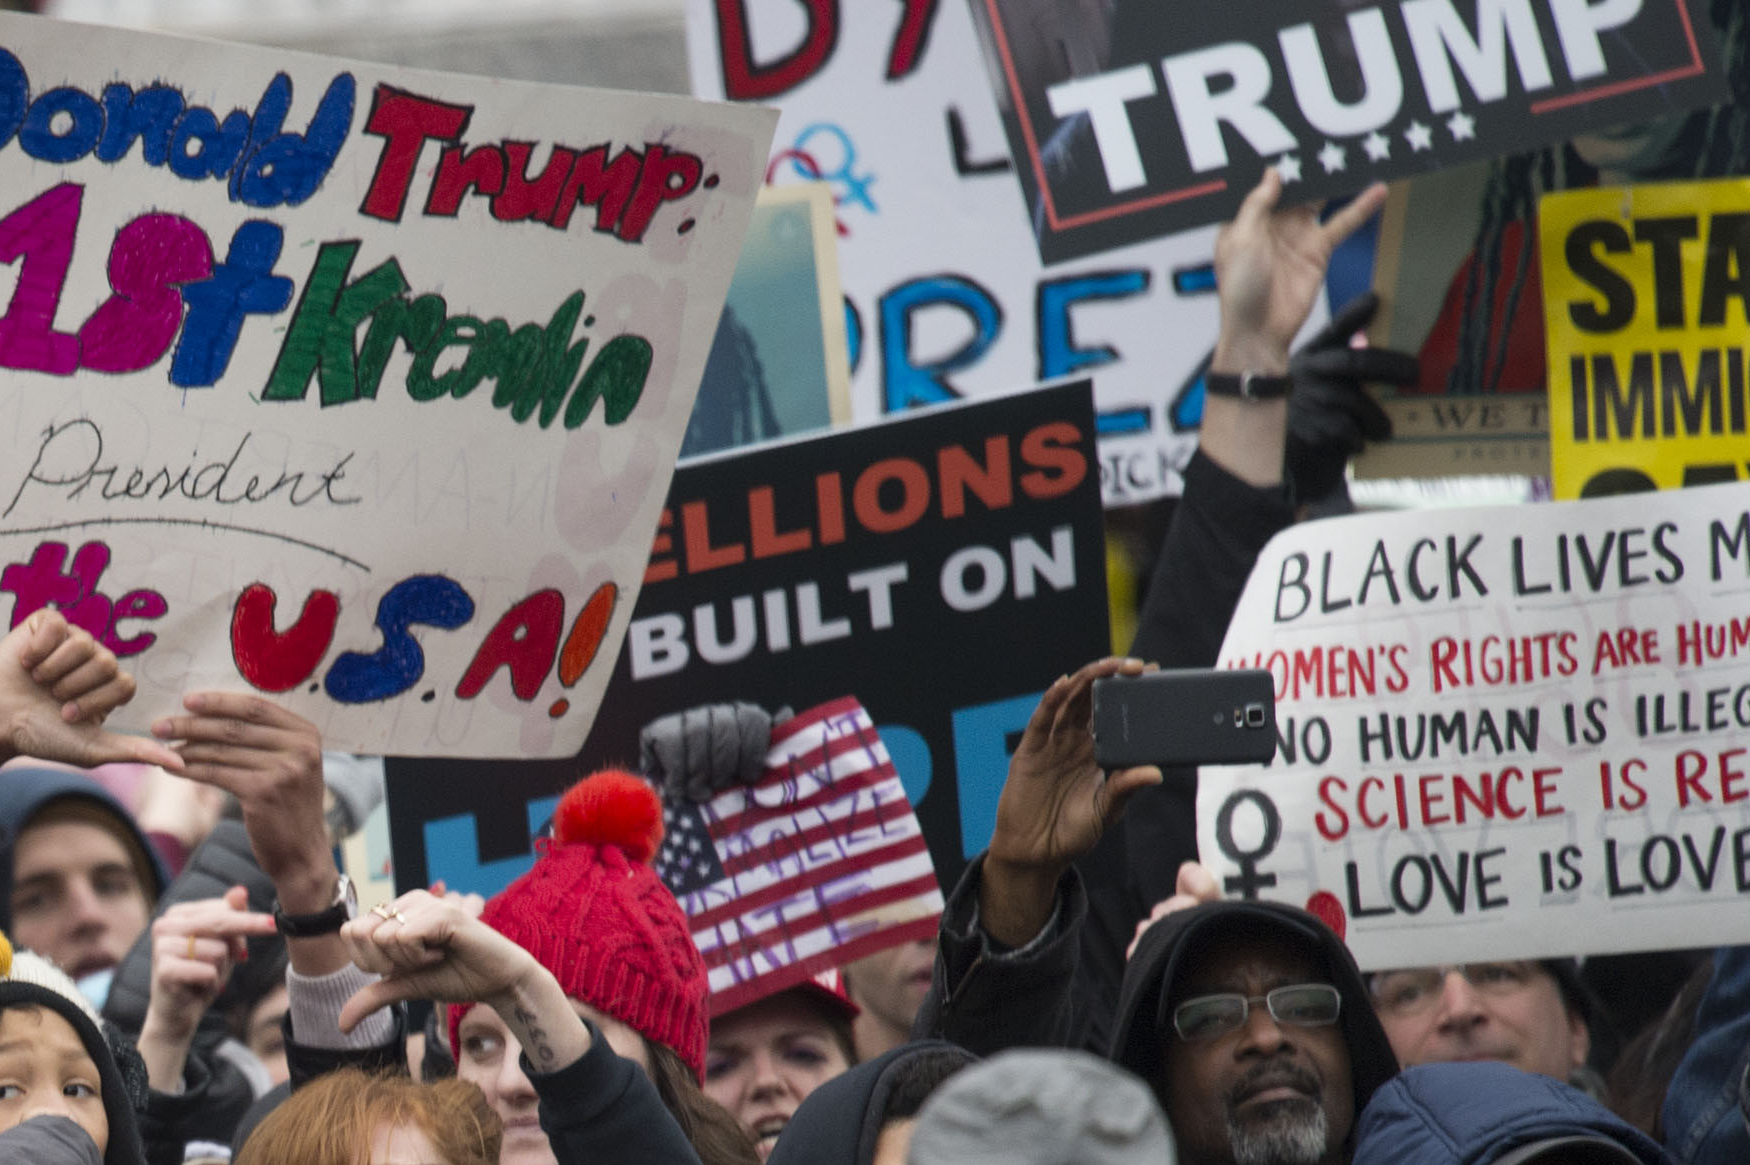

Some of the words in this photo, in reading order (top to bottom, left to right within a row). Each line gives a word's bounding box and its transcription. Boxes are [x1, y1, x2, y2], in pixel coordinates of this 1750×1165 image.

[1047, 0, 1646, 194] TRUMP
[260, 239, 654, 430] Kremlin
[844, 268, 1218, 432] RE
[1, 418, 362, 519] President
[628, 562, 909, 682] BUILT
[940, 525, 1077, 612] ON
[1273, 533, 1489, 624] BLACK
[1513, 520, 1685, 597] LIVES
[1228, 645, 1410, 703] OMEN'S
[1430, 630, 1578, 694] RIGHTS
[1592, 625, 1662, 676] ARE
[1358, 707, 1540, 764] HUMAN
[1563, 697, 1608, 745] IS
[1315, 766, 1565, 842] SCIENCE
[1600, 757, 1648, 812] IS
[1346, 846, 1509, 919] LOVE
[1540, 843, 1583, 893] IS
